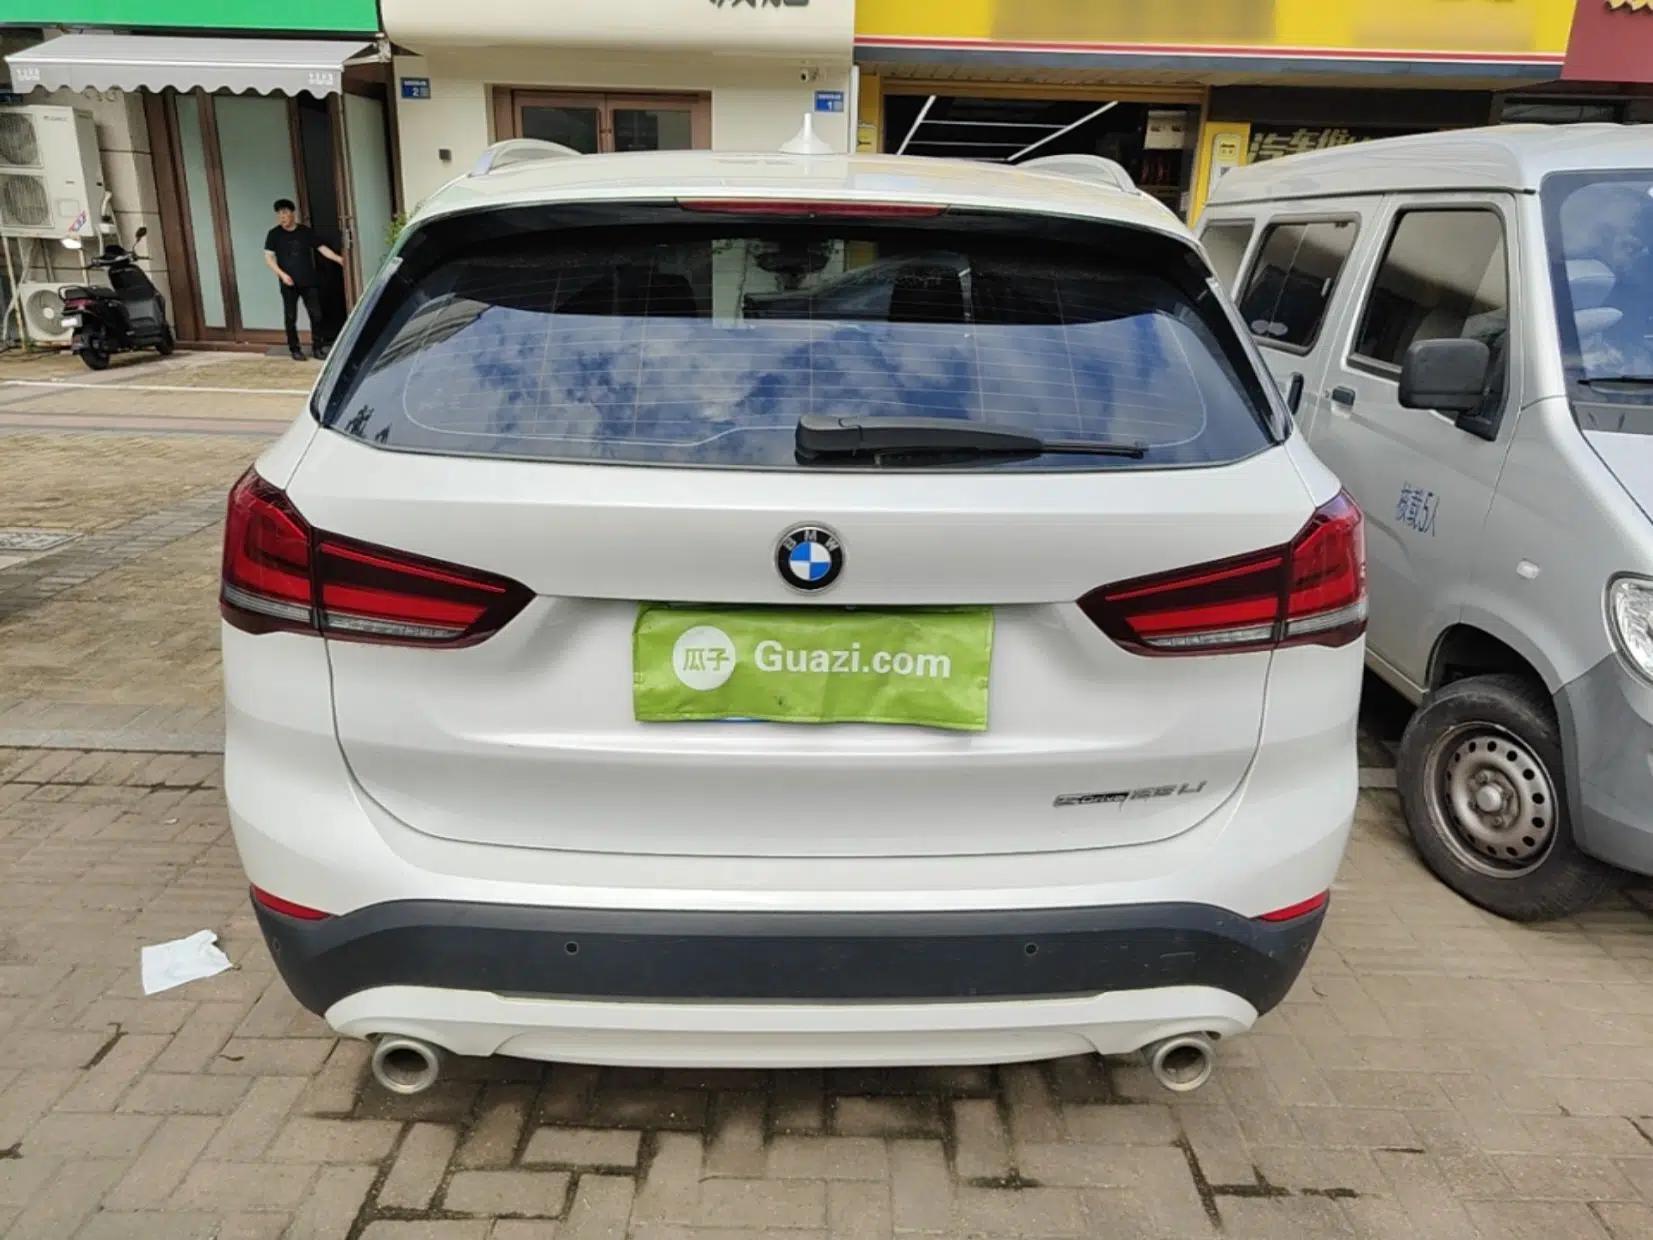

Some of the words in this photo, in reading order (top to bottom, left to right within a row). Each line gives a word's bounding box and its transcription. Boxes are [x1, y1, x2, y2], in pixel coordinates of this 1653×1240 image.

[1248, 128, 1374, 163] 汽车维
[782, 528, 840, 551] BMW
[682, 648, 731, 672] 瓜子
[754, 640, 951, 679] Guazi.com
